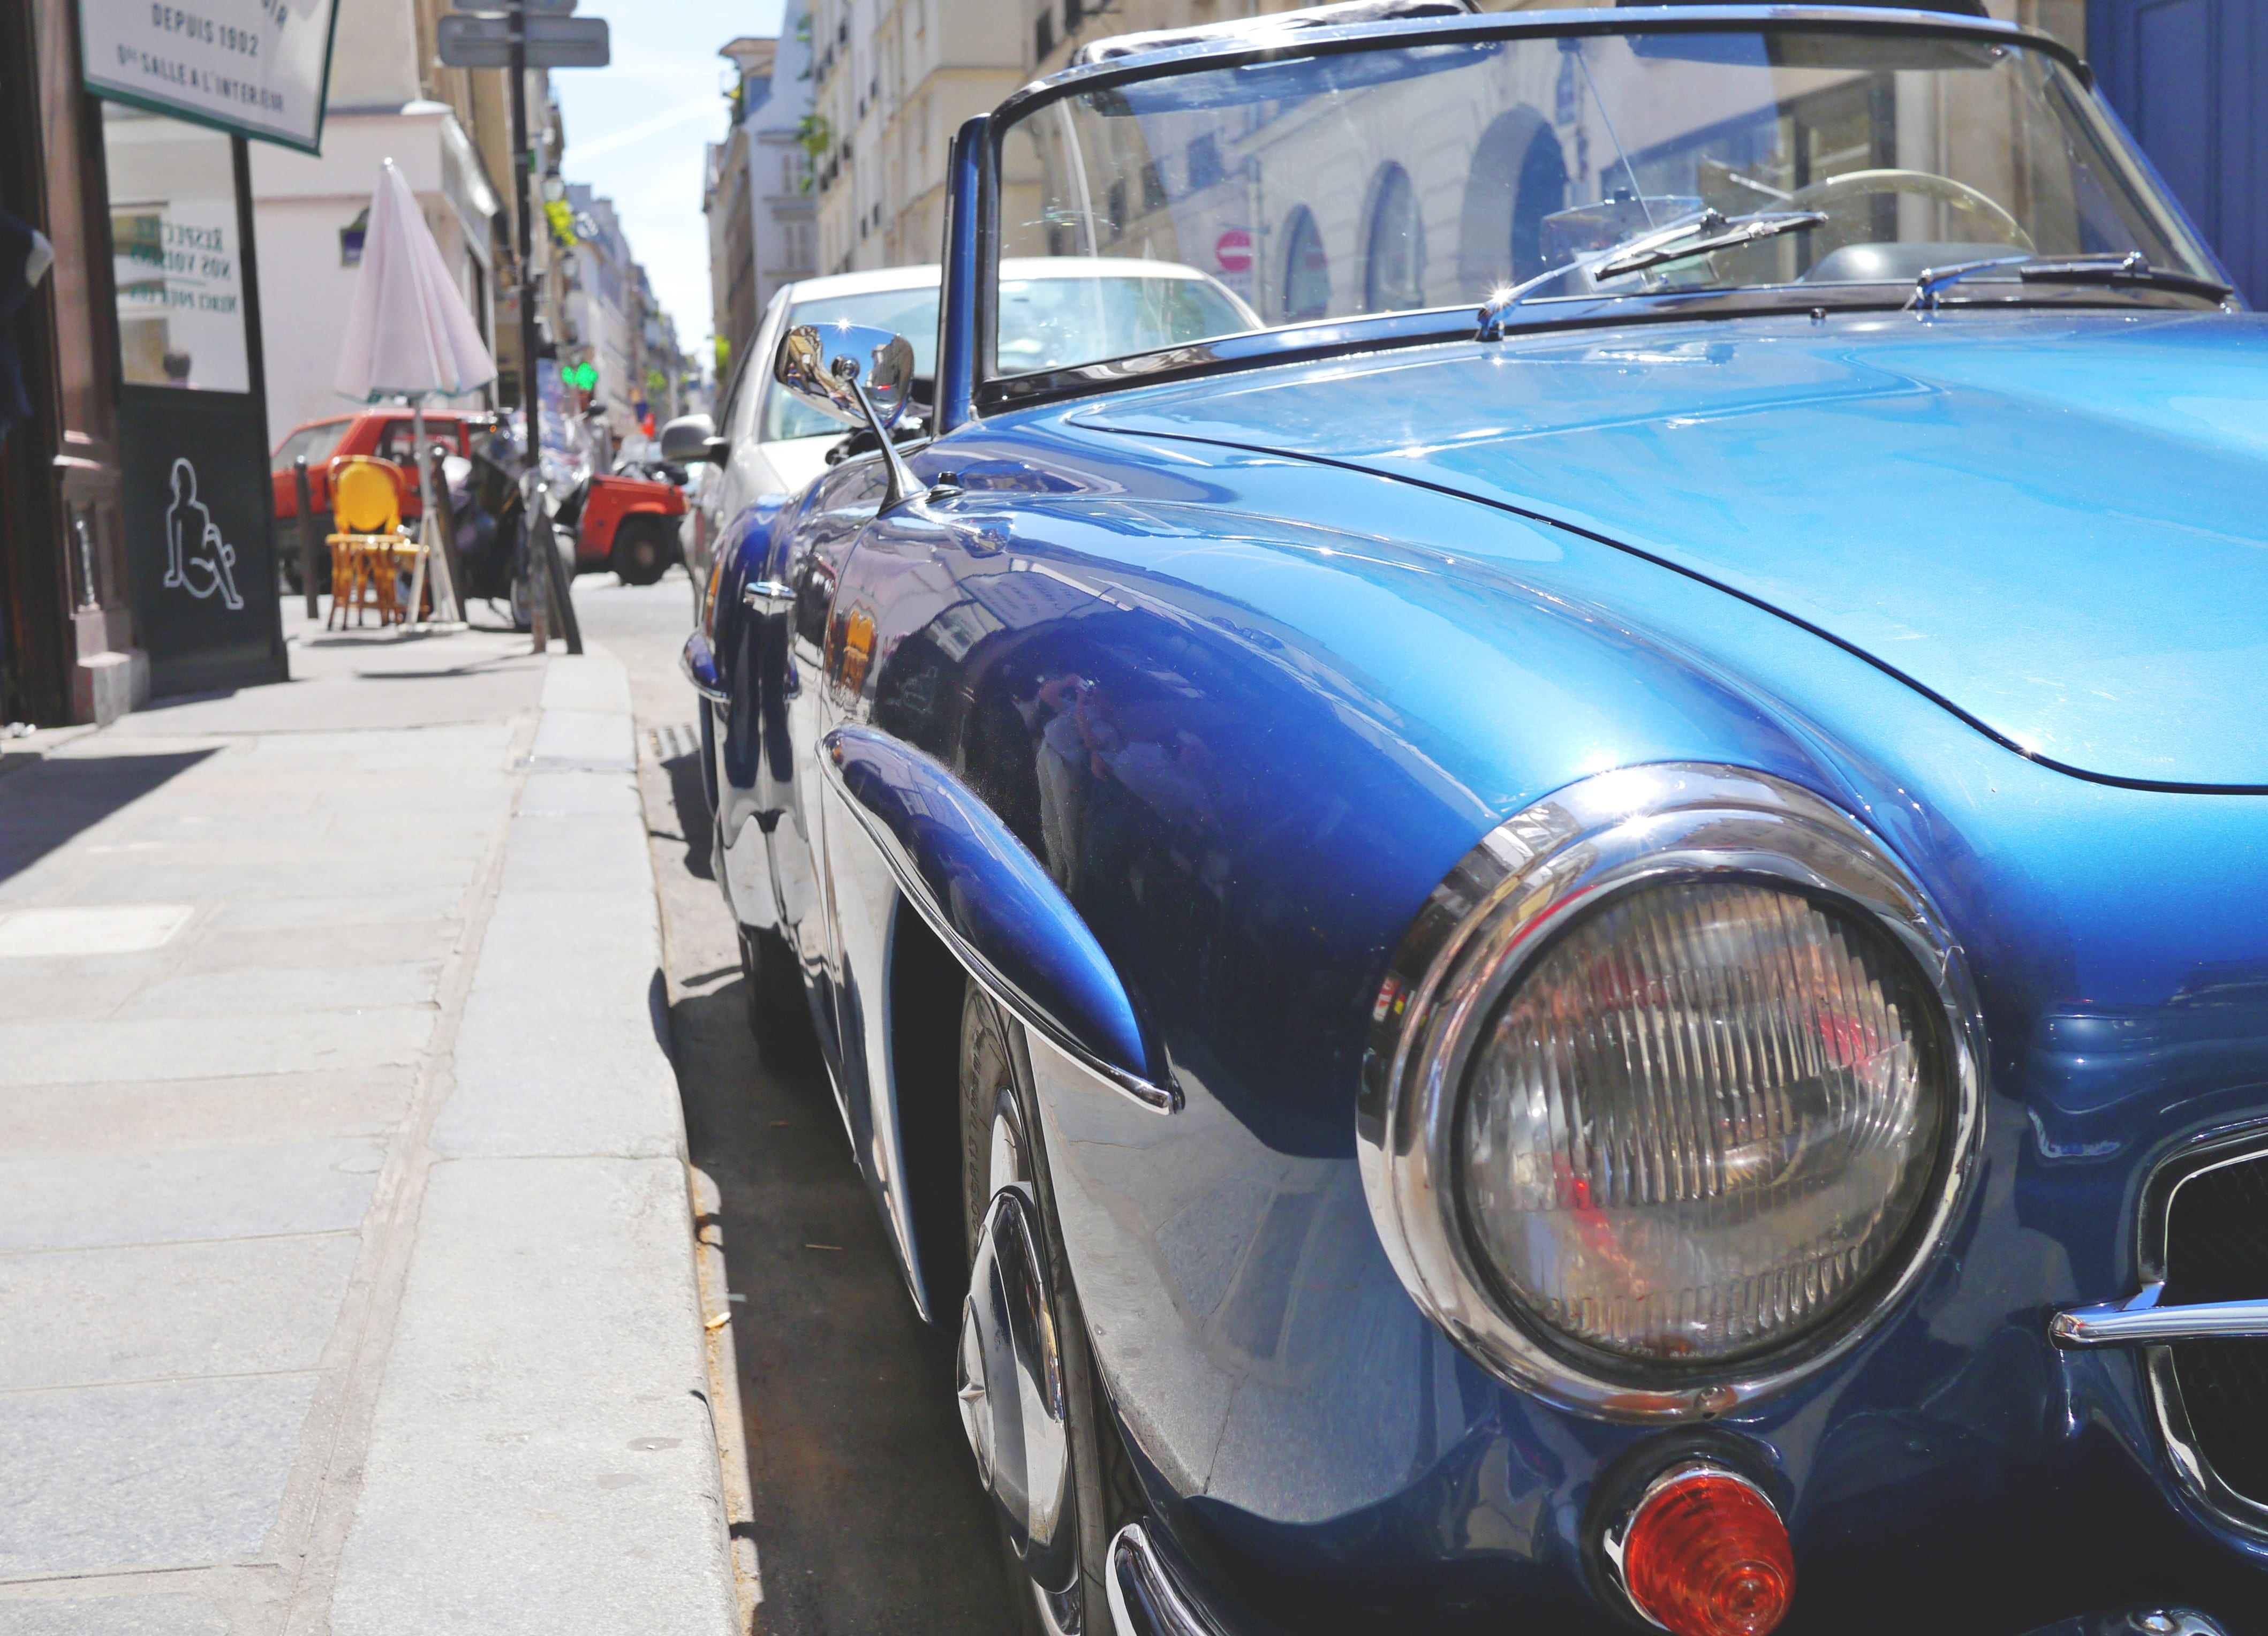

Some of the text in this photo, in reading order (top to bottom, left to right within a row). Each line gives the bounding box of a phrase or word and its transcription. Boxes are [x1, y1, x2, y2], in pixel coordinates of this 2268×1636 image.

[152, 2, 259, 57] DEPUIS 1902
[141, 51, 186, 86] SALLE
